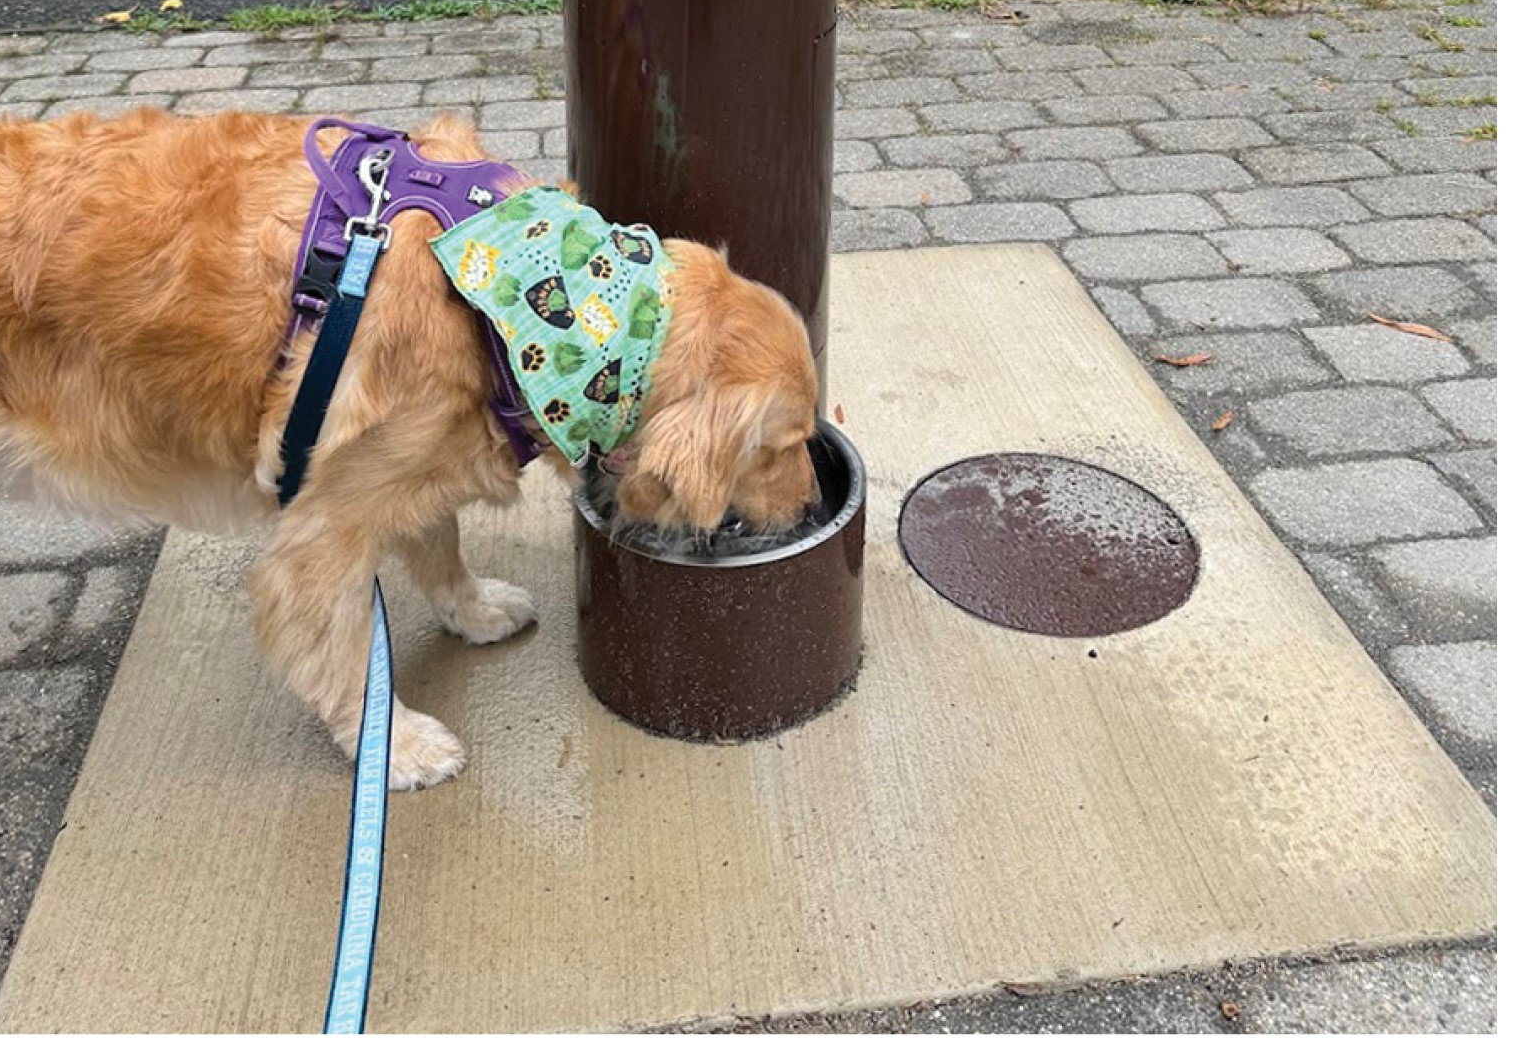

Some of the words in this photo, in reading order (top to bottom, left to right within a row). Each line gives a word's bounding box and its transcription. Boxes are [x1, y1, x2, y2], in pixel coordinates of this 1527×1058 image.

[365, 647, 387, 738] CAROLINA
[361, 745, 383, 779] TAR
[360, 783, 380, 838] HEELS
[343, 873, 373, 972] CAROLINA
[336, 975, 363, 1017] TAR
